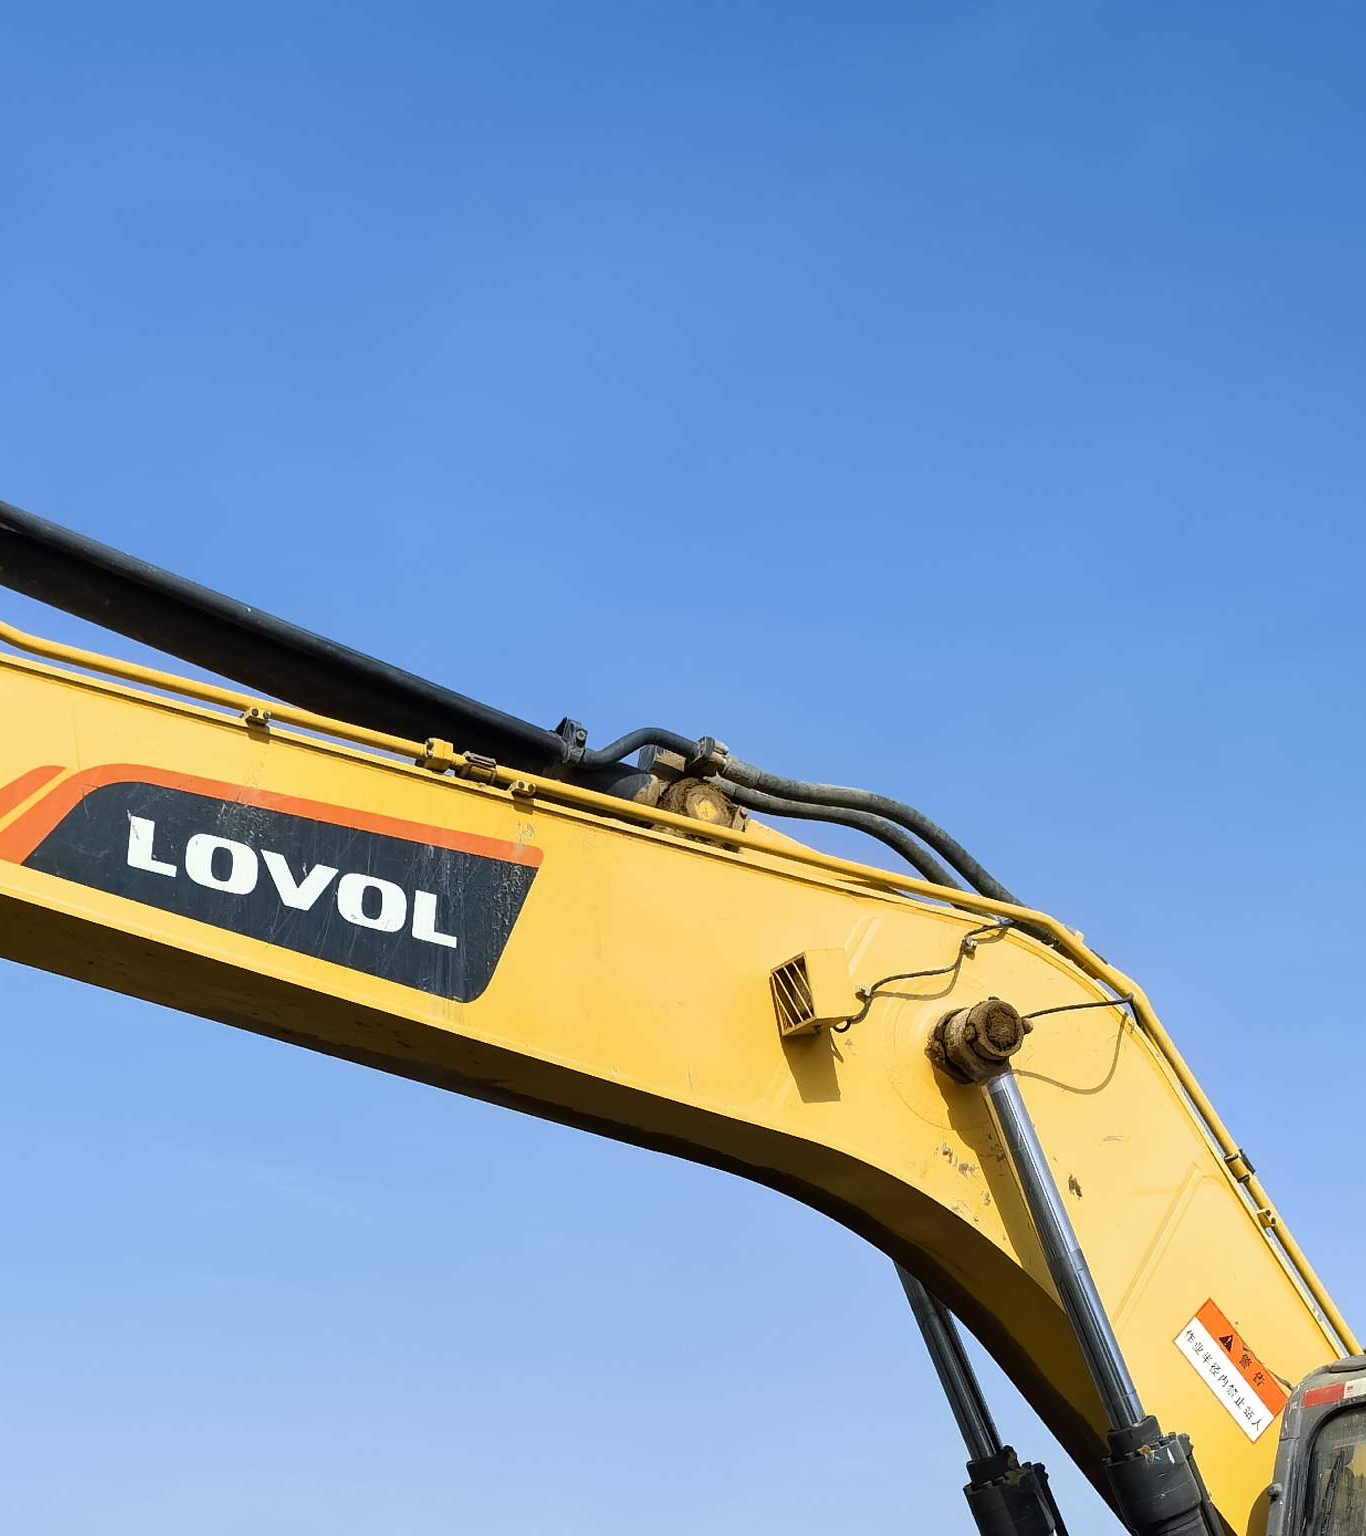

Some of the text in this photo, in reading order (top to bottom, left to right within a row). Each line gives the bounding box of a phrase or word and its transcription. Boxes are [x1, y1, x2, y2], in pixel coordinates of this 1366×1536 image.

[126, 812, 458, 949] LOVOL
[1184, 1329, 1263, 1432] 作业半径内禁止站人
[1238, 1353, 1267, 1388] 警告
